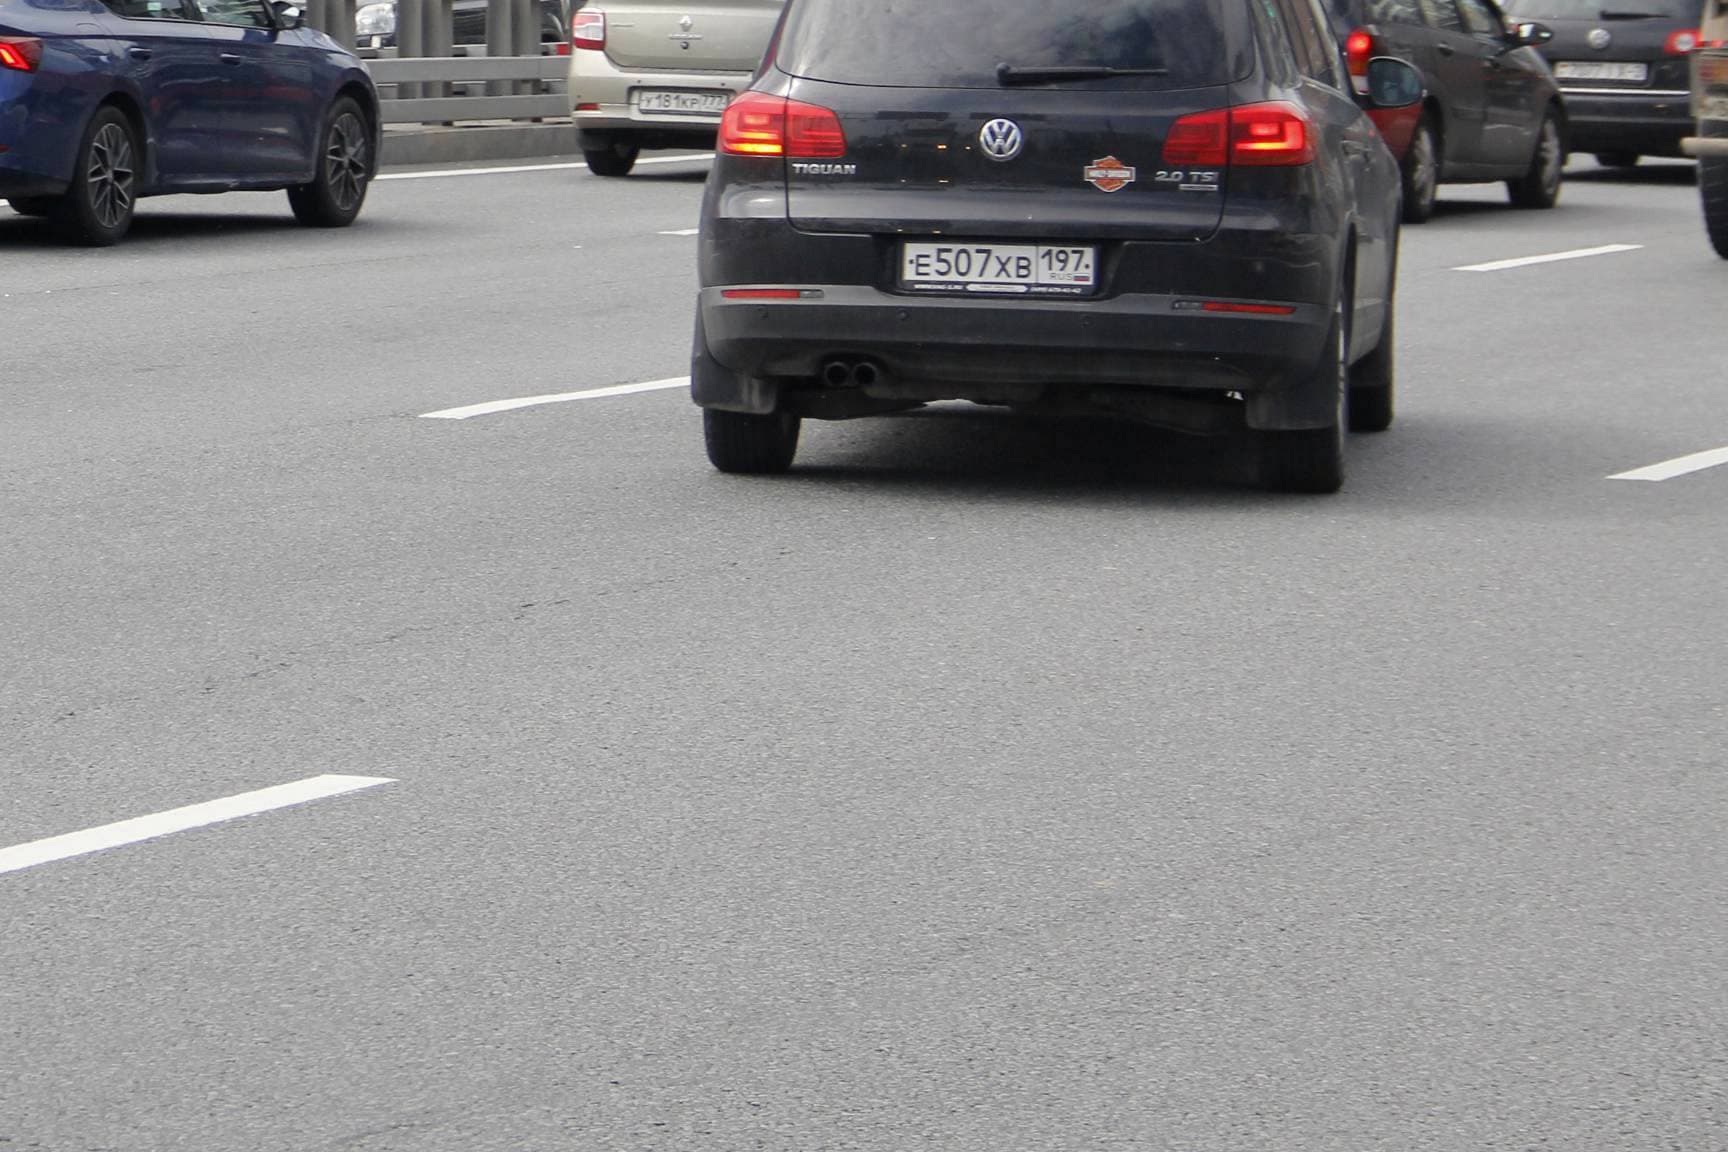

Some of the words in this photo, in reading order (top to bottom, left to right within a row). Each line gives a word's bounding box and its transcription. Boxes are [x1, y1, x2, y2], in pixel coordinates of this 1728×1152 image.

[791, 163, 856, 175] TIGUAN
[1189, 171, 1219, 182] TSI
[1041, 248, 1085, 273] 197
[1049, 273, 1073, 281] RUS
